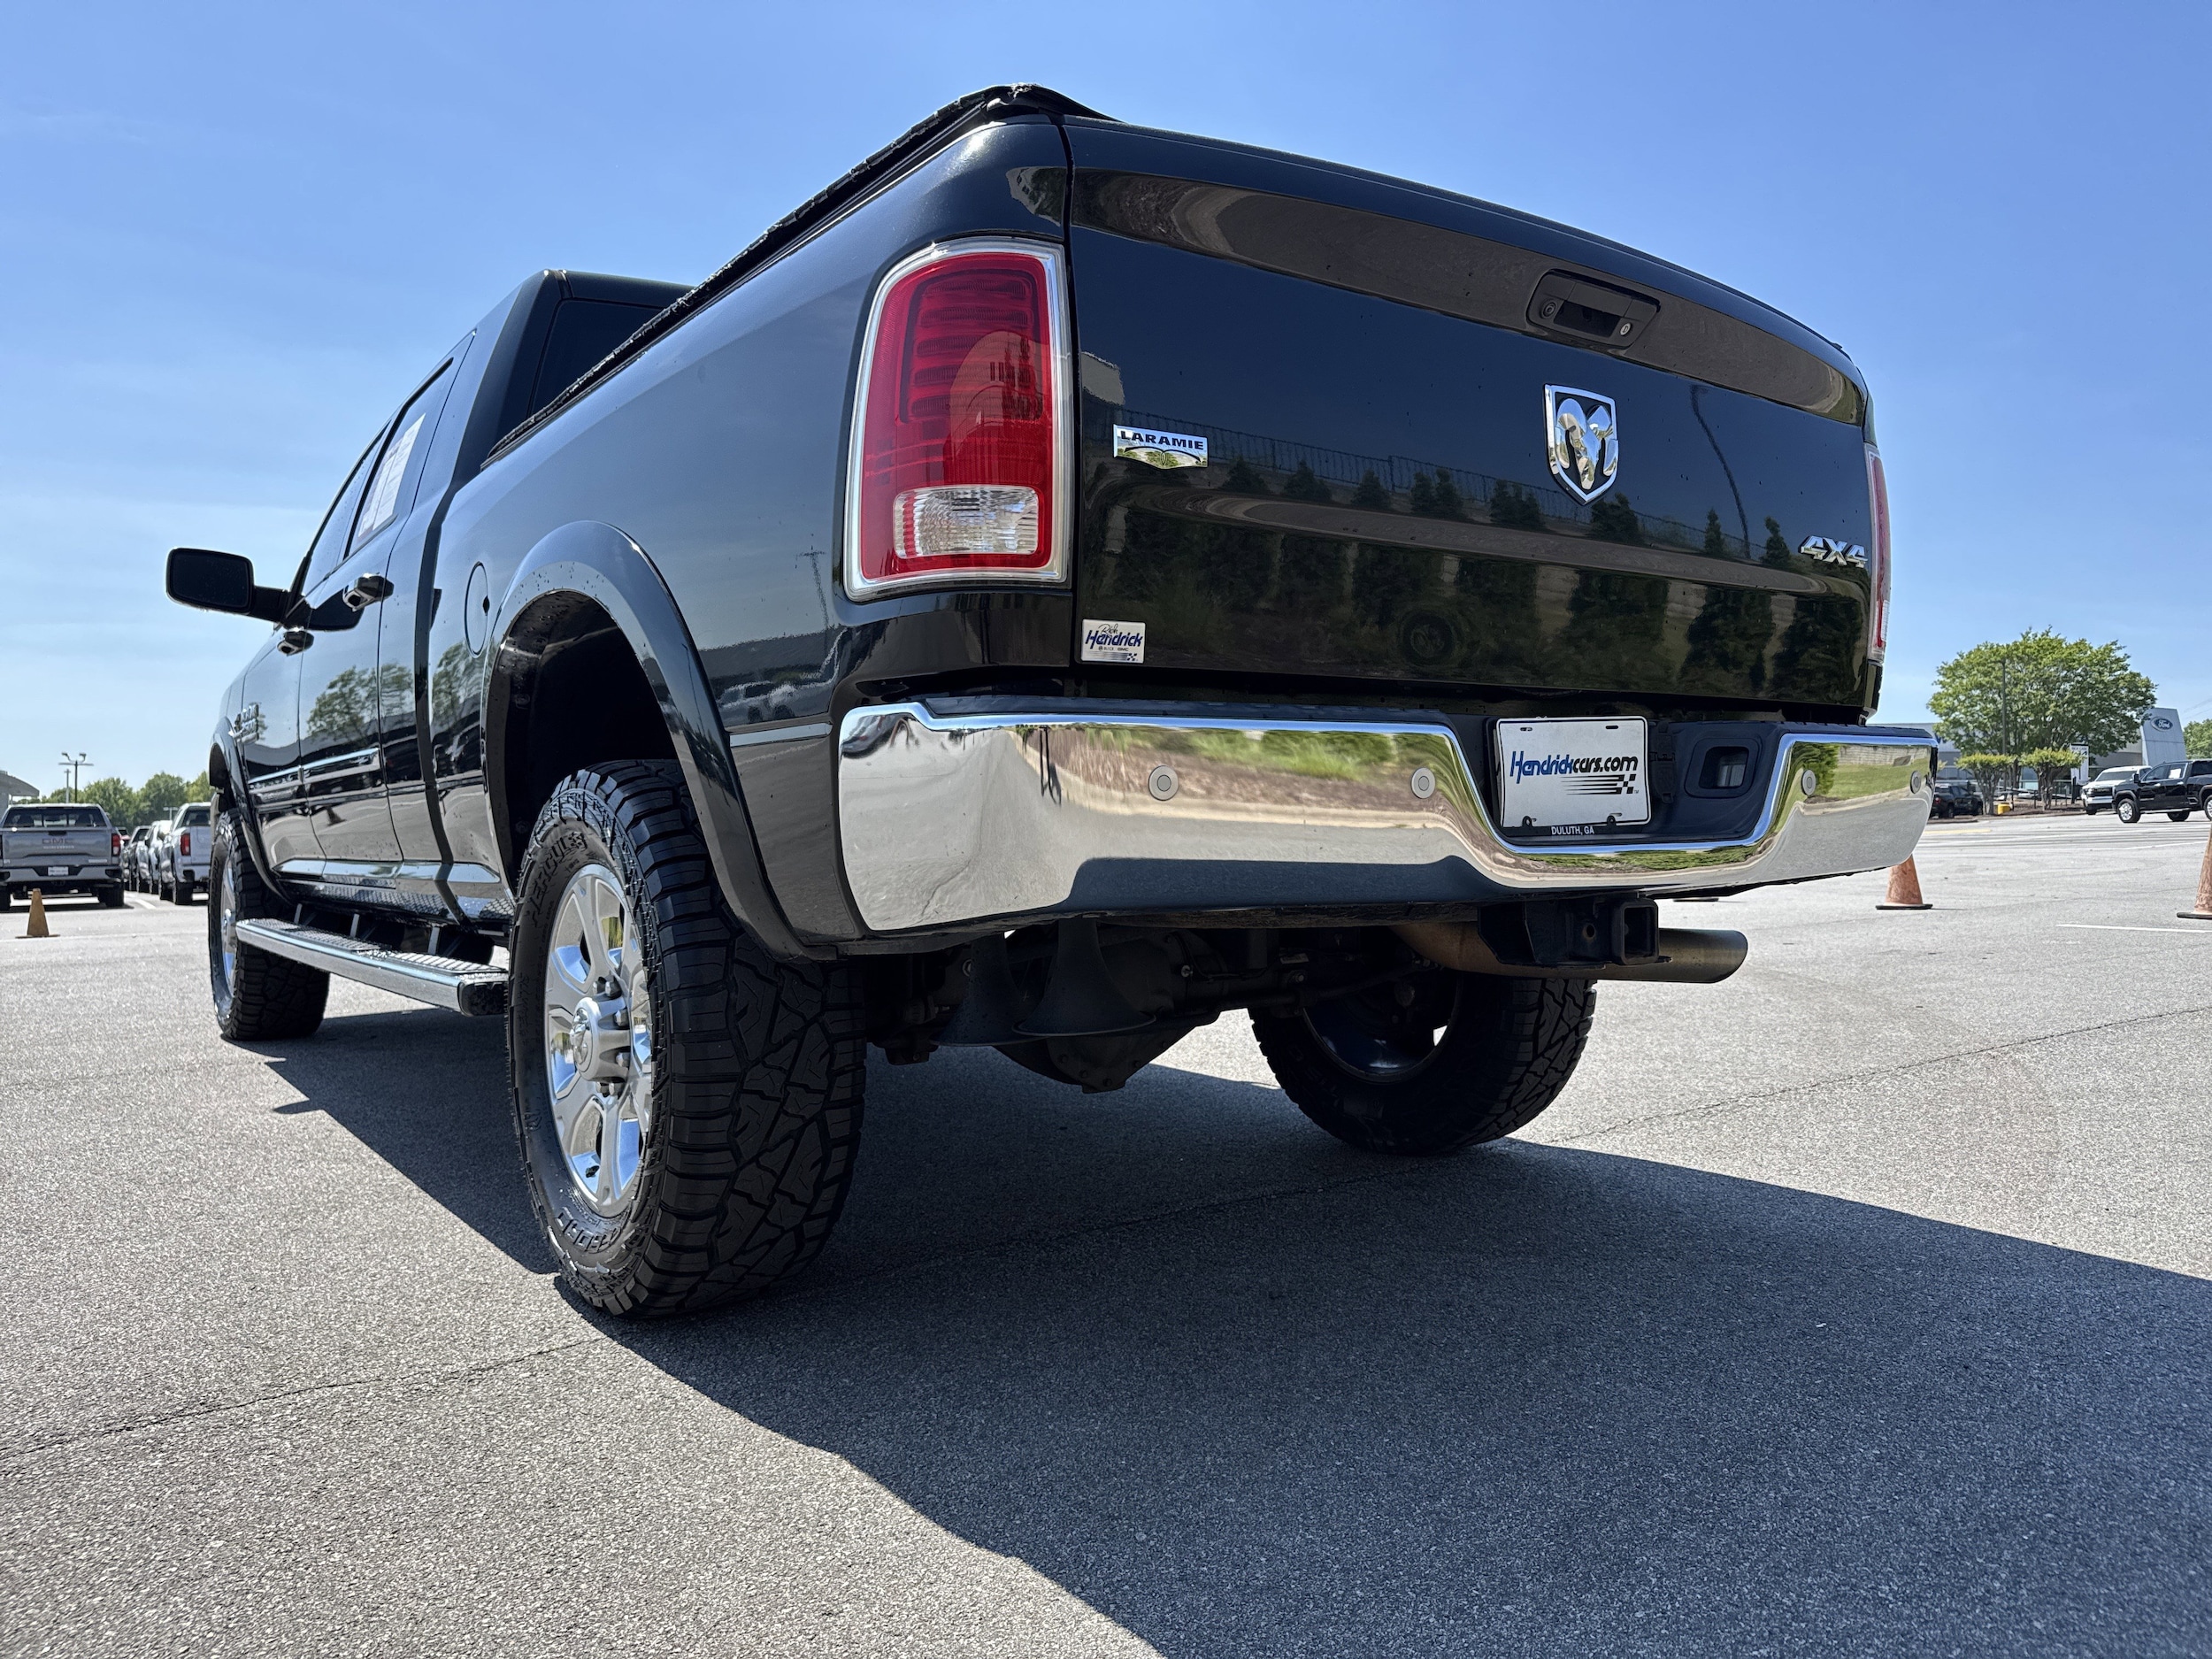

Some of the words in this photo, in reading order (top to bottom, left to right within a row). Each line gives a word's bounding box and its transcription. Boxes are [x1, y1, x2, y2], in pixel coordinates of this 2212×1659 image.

[1119, 430, 1205, 450] LARAMIE
[1085, 629, 1143, 649] Hendrick
[1509, 750, 1639, 784] Hendrickcars.com
[1551, 826, 1583, 836] DULUTH,
[1584, 826, 1595, 834] GA
